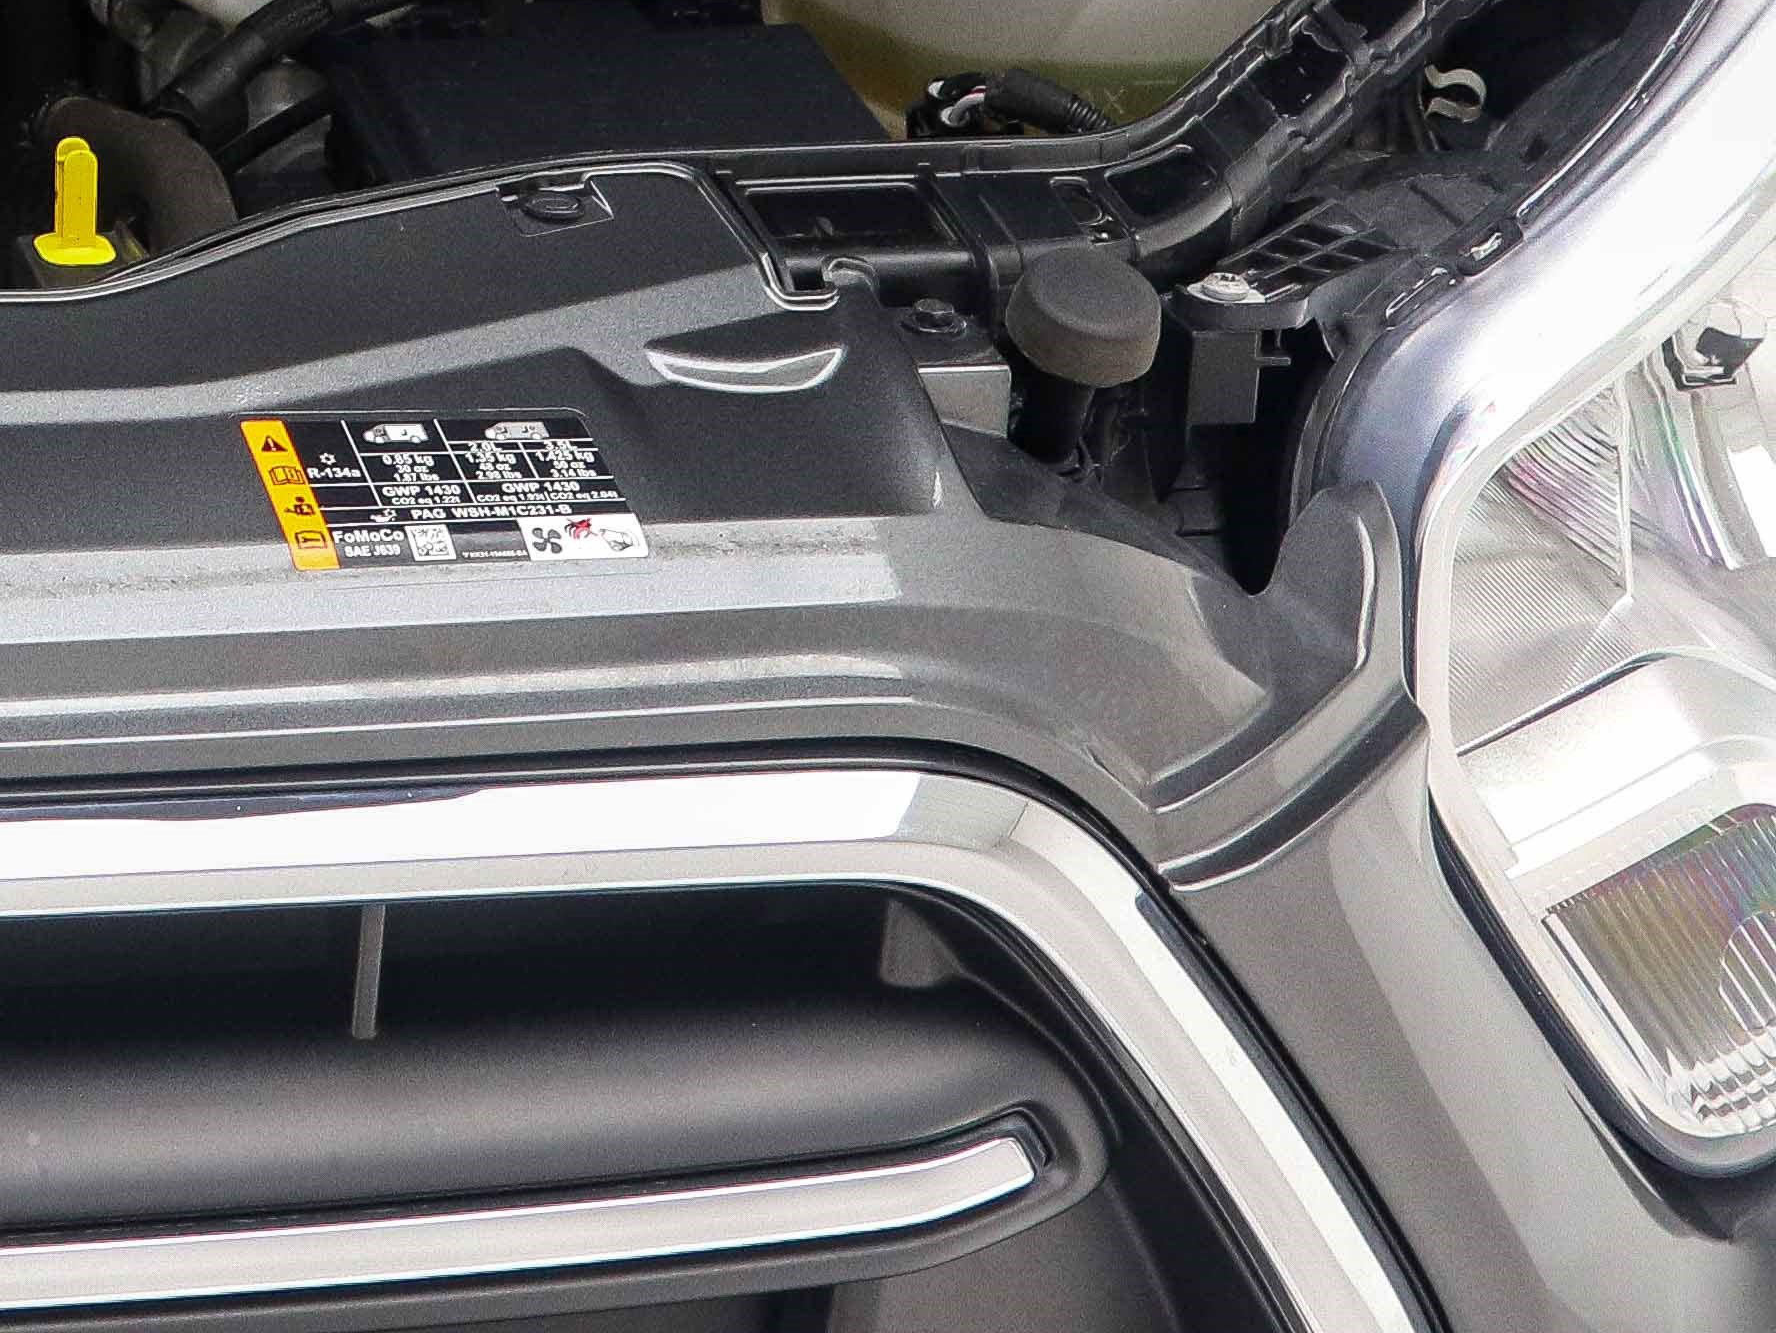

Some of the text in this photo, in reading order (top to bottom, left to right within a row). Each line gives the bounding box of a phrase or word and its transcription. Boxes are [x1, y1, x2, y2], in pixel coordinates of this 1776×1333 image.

[414, 453, 435, 467] kg
[497, 451, 517, 465] kg
[574, 450, 596, 464] kg
[413, 465, 430, 474] oz
[495, 462, 511, 471] oz
[570, 460, 586, 470] oz
[306, 468, 362, 480] R-134a
[419, 472, 440, 482] lbs
[502, 470, 523, 480] lbs
[576, 468, 597, 478] lbs
[382, 484, 461, 497] GWP 1430
[501, 481, 580, 494] GWP 1430
[410, 507, 447, 521] PAG
[333, 529, 405, 544] FoMoCo
[344, 545, 372, 558] SAE
